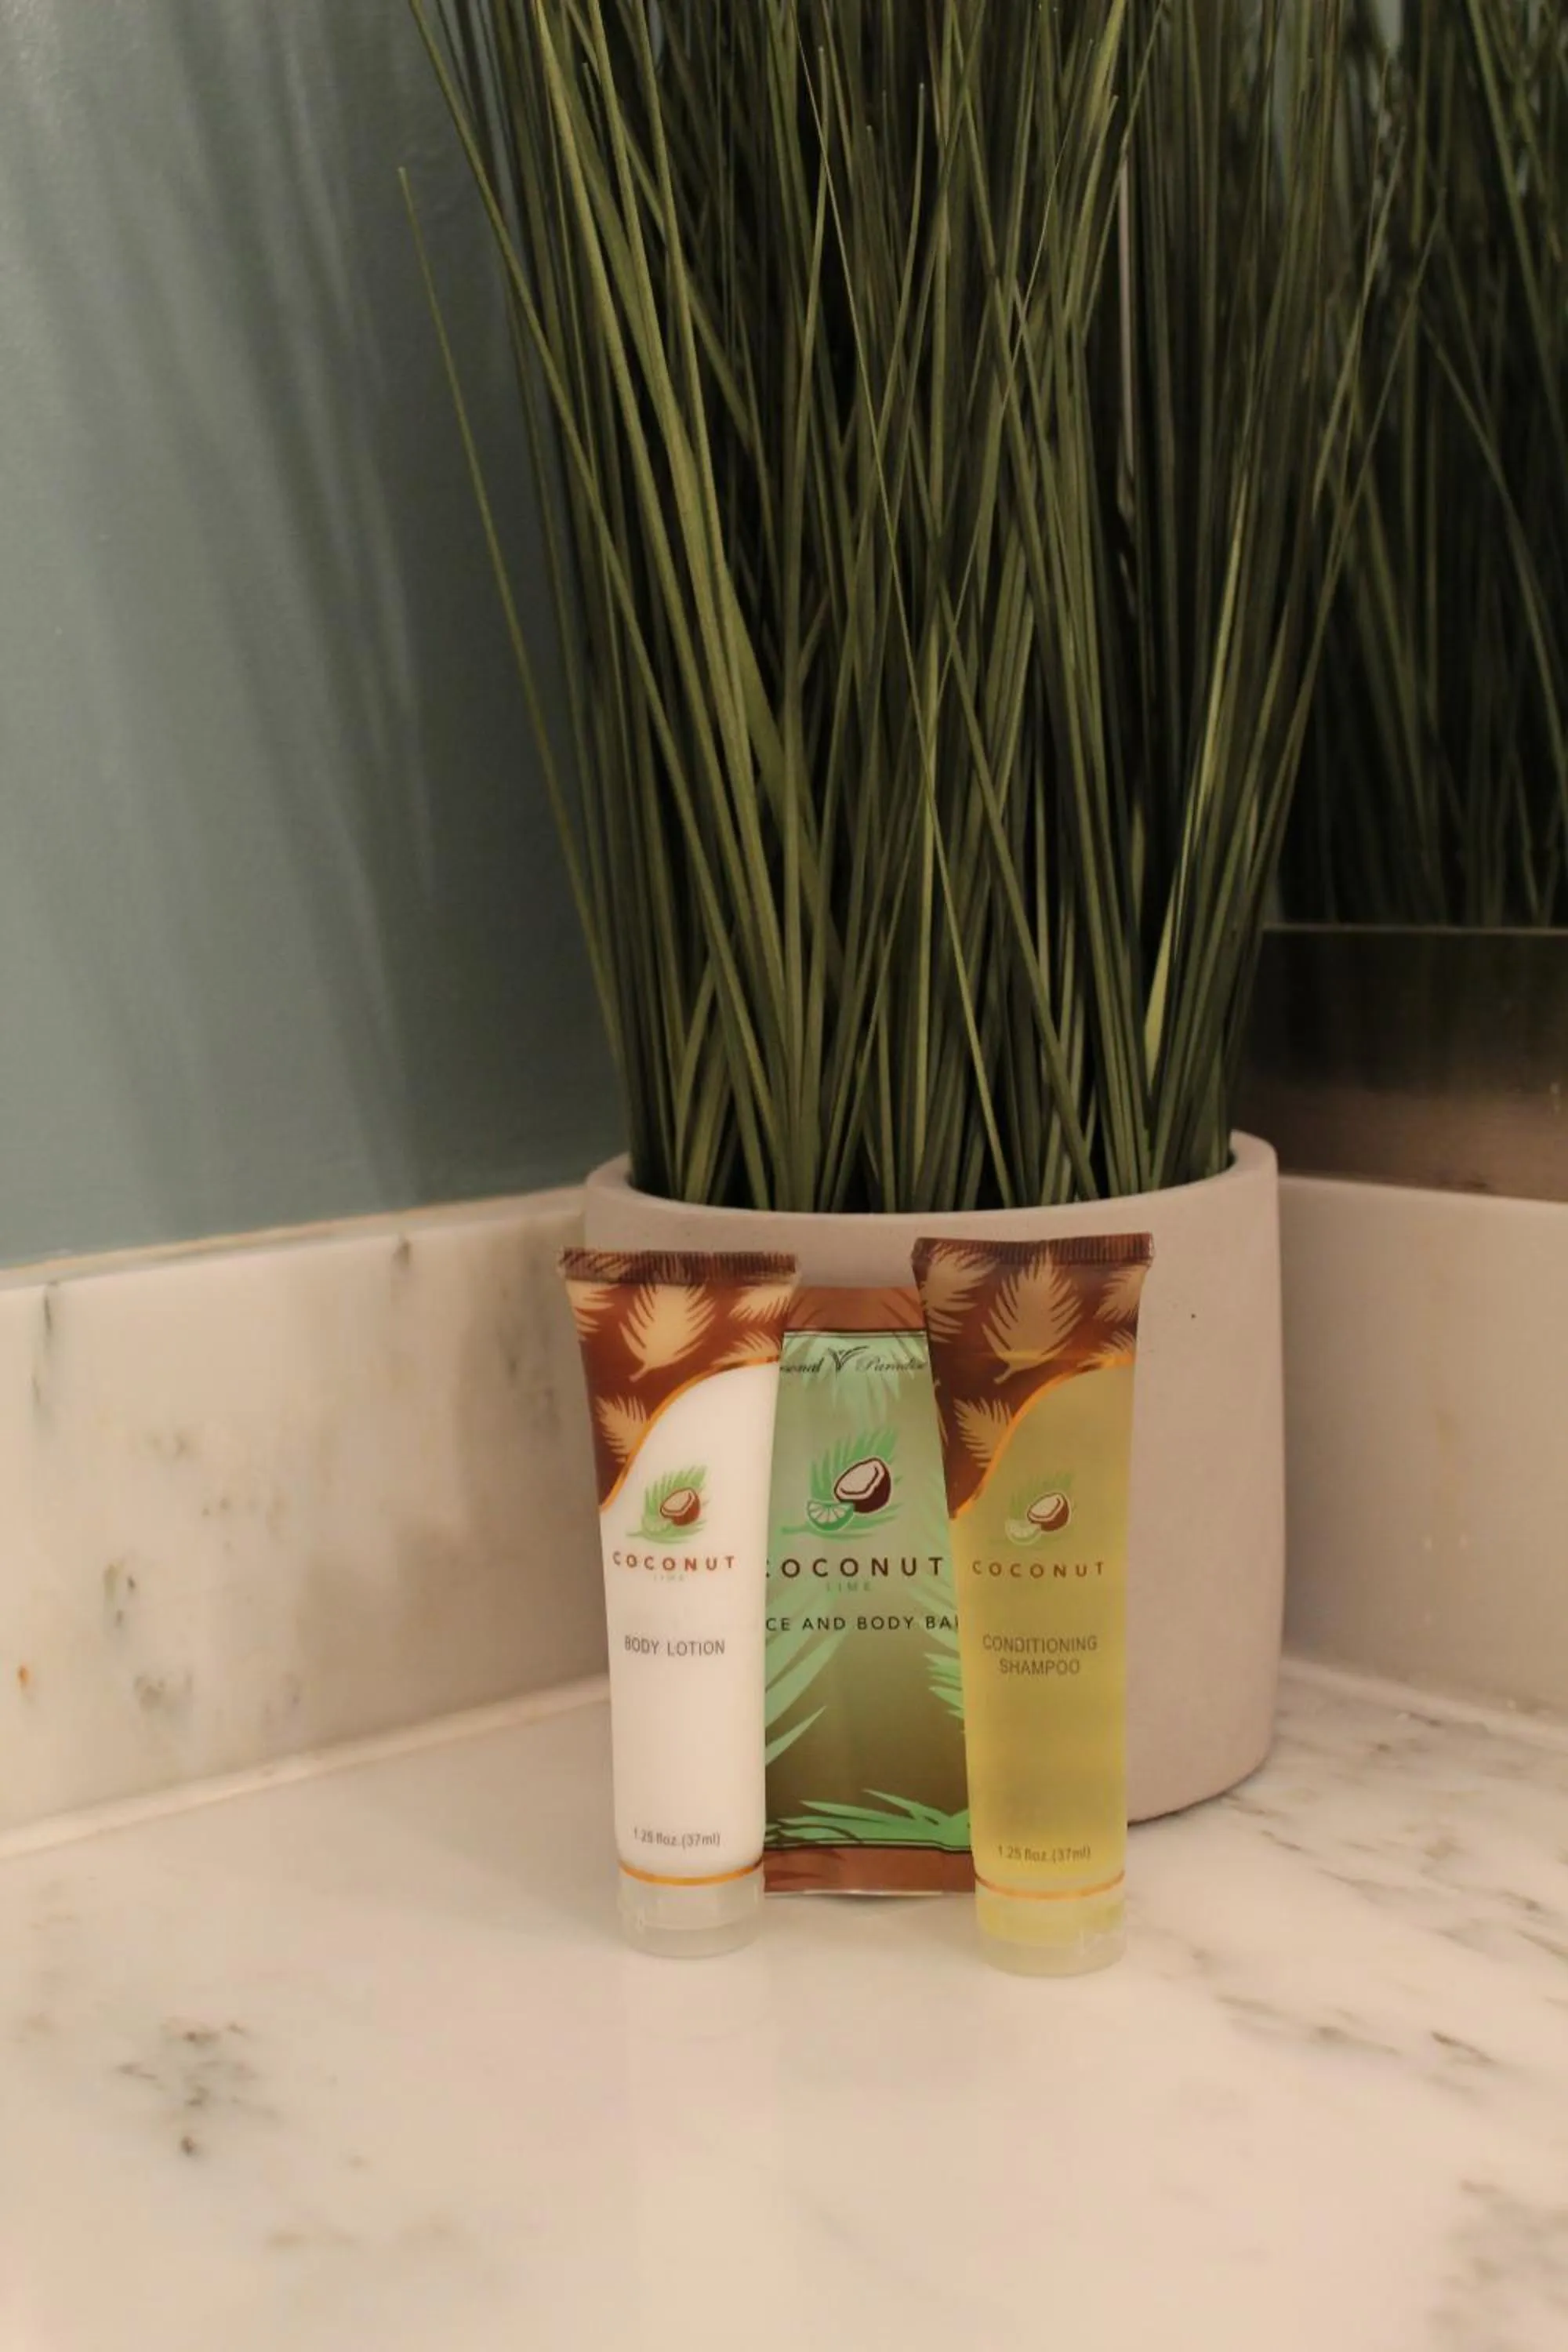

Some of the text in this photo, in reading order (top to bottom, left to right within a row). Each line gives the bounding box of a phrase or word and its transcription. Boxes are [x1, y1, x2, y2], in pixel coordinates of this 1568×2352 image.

[612, 1551, 735, 1571] COCONUT
[971, 1560, 1104, 1579] COCONUT
[826, 1581, 872, 1592] LIME
[765, 1617, 791, 1632] CE
[802, 1617, 847, 1631] AND
[856, 1616, 914, 1631] BODY
[624, 1635, 726, 1657] BODY LOTION
[982, 1634, 1098, 1653] CONDITIONING
[999, 1657, 1080, 1675] SHAMPOO
